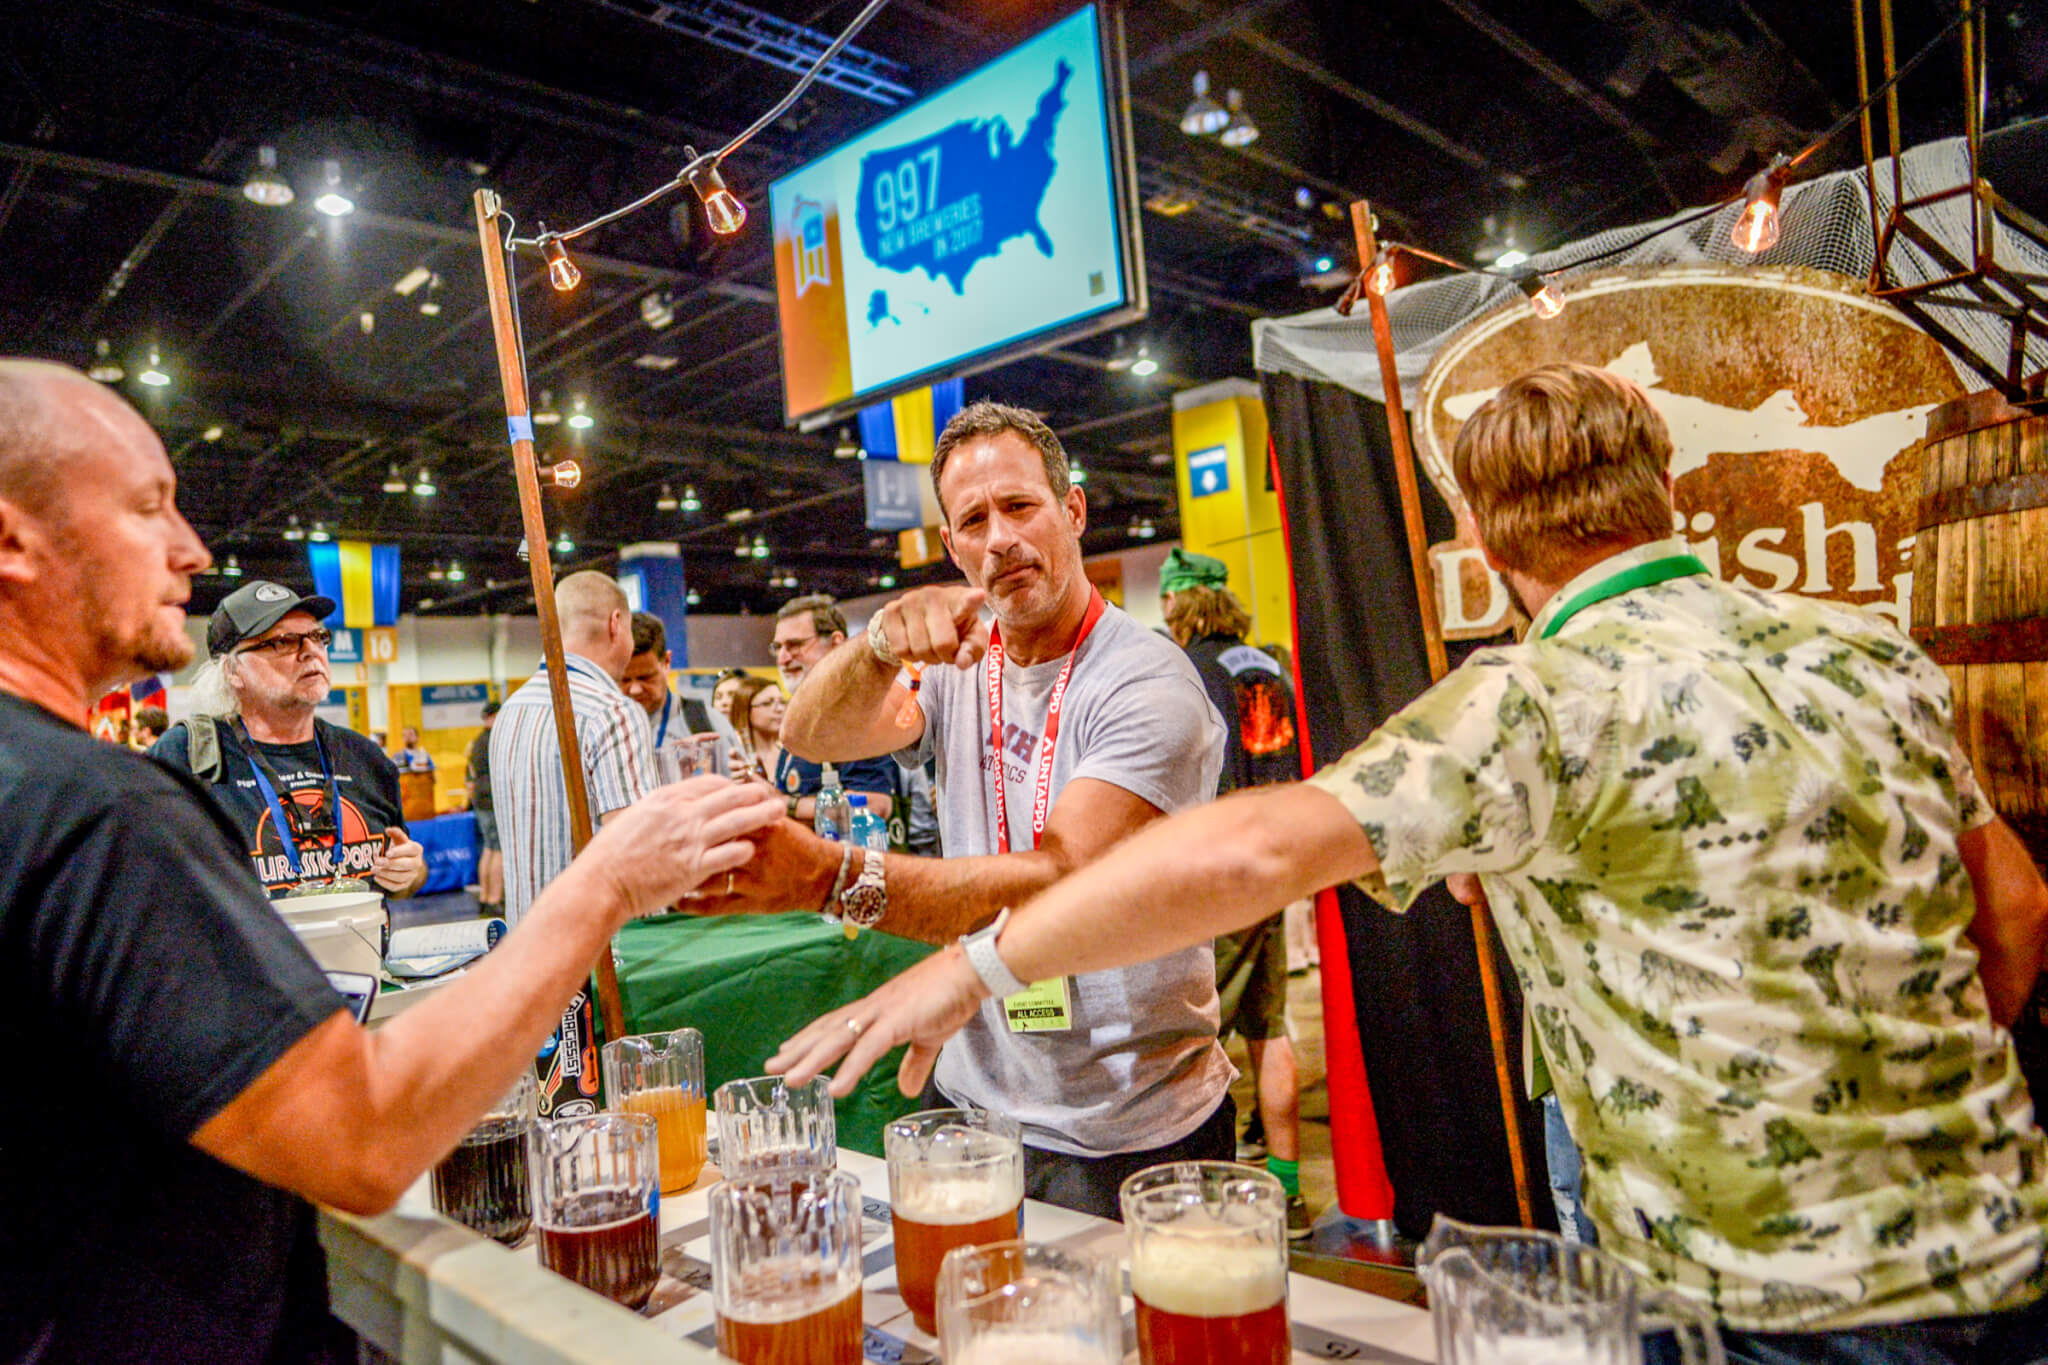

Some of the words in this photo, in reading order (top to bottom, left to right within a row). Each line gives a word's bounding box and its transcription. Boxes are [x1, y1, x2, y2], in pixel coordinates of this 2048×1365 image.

[876, 145, 941, 232] 997
[909, 193, 981, 245] BREWERIES
[951, 218, 983, 253] 2017
[369, 634, 393, 660] 10
[989, 644, 1002, 711] UNTAPPD
[994, 750, 1004, 823] UNTAPPD
[1033, 756, 1052, 833] UNTAPPD
[338, 842, 383, 873] PORK
[1030, 1007, 1055, 1017] ACCESS
